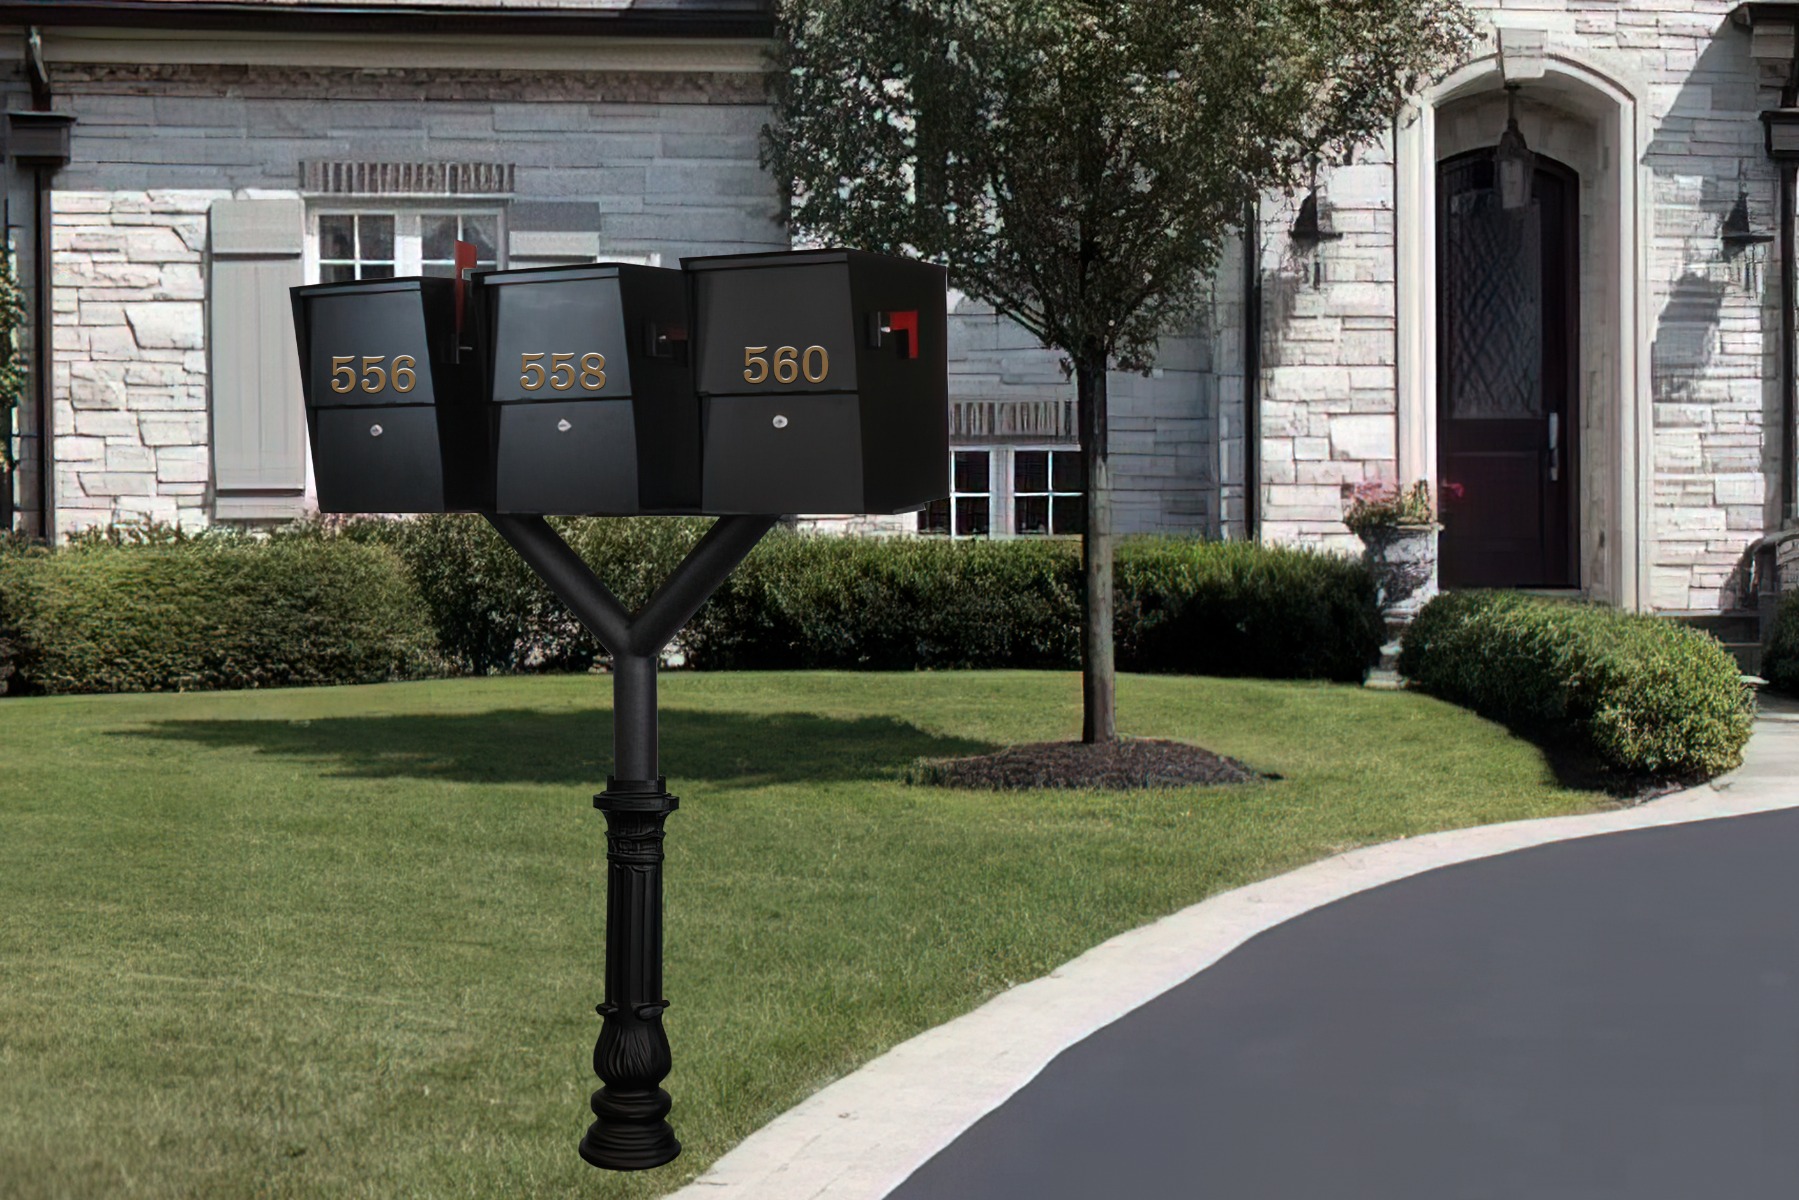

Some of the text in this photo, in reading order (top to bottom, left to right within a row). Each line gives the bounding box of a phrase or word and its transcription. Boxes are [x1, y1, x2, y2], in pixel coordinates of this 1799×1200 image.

[330, 354, 417, 394] 556
[519, 352, 607, 392] 558
[742, 345, 829, 385] 560
